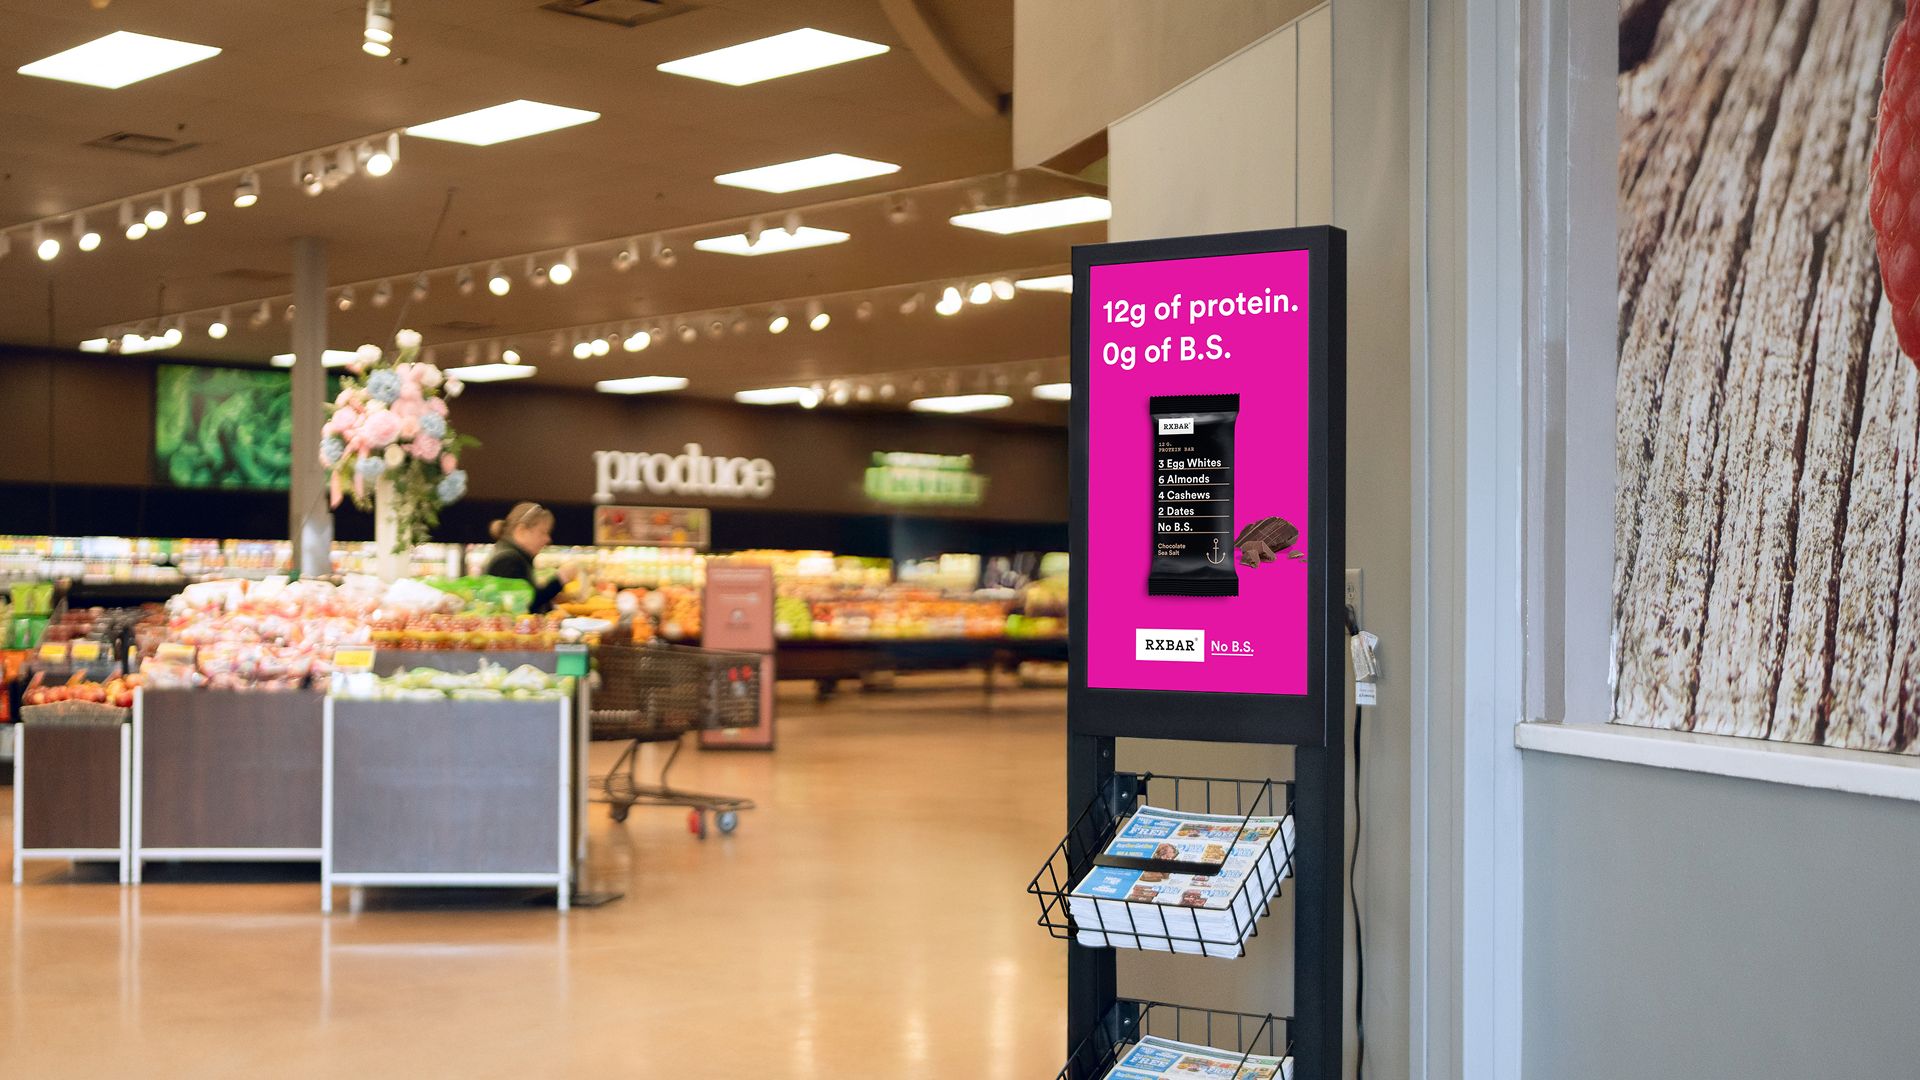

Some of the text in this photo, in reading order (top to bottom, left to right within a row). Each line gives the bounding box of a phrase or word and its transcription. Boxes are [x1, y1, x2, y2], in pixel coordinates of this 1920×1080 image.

[1103, 287, 1299, 328] 12g of protein.
[1103, 334, 1231, 370] 0g of B.S.
[1158, 457, 1222, 470] 3 Egg Whites
[592, 443, 776, 503] produce
[1158, 473, 1210, 484] 6 Almonds
[1158, 489, 1211, 500] 4 Cashews
[1158, 506, 1195, 516] 2 Dates
[1157, 522, 1193, 532] No B.S.
[1211, 640, 1229, 652] No
[1231, 640, 1255, 653] B.S.
